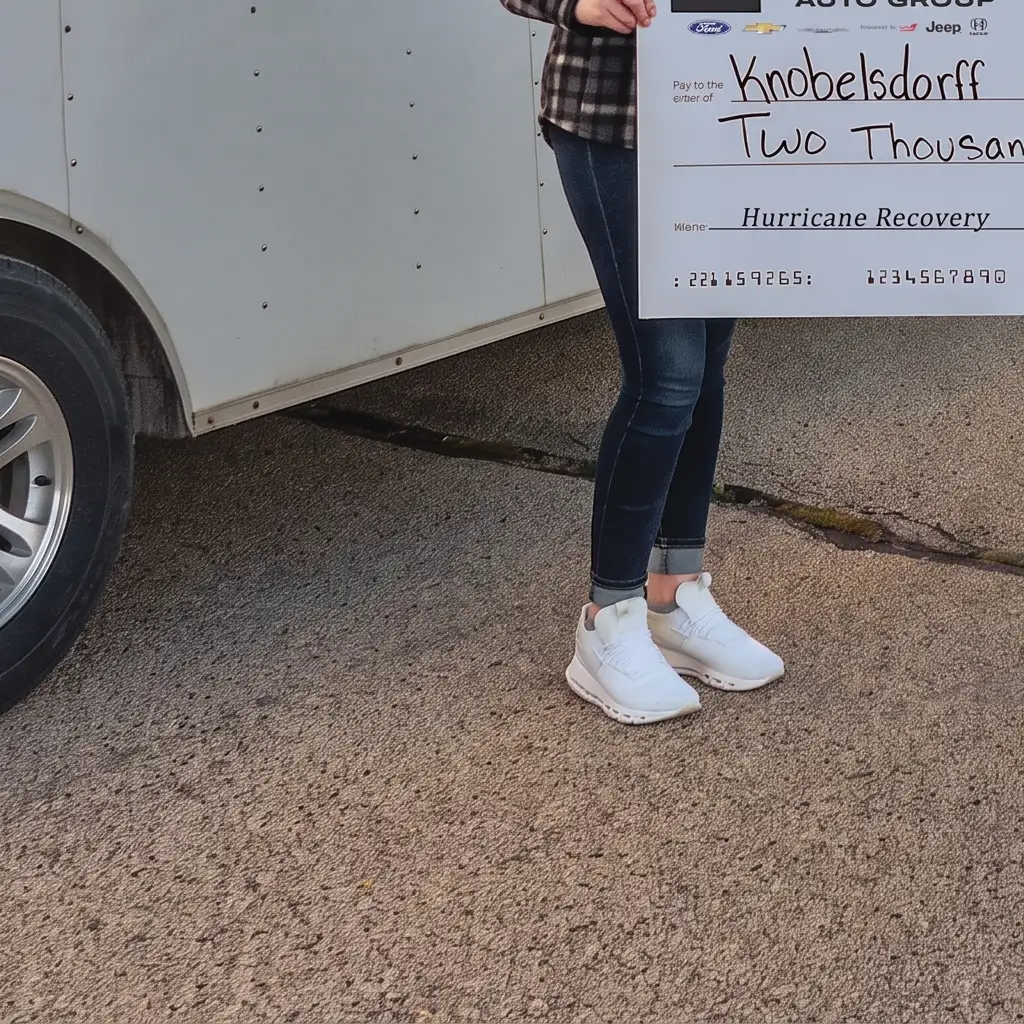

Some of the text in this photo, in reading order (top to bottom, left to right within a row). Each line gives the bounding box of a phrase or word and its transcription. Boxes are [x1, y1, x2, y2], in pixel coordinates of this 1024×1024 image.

[925, 20, 962, 35] Jeep
[729, 44, 985, 103] Knobelsdorff
[673, 80, 724, 91] Pay to the
[702, 93, 714, 102] of
[718, 112, 827, 158] Two
[741, 207, 990, 233] Hurricane Recovery
[867, 269, 1007, 285] 1234567890
